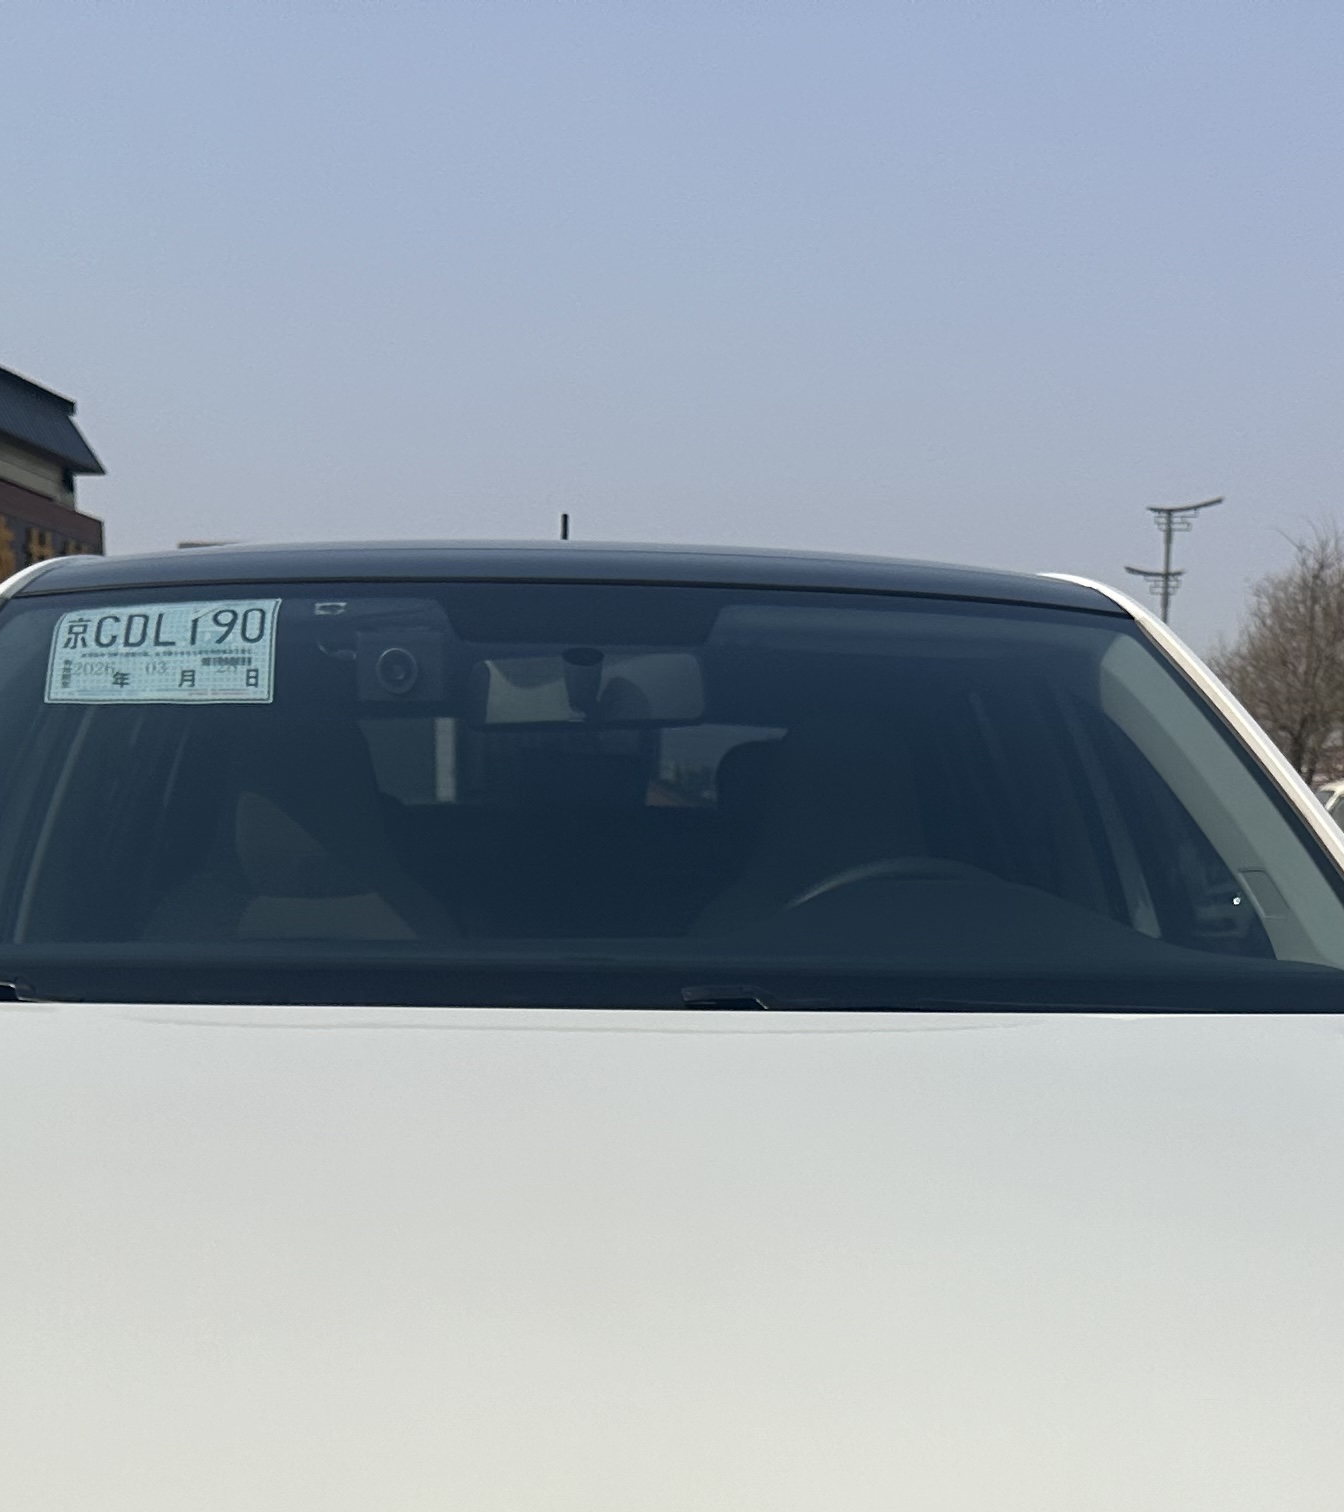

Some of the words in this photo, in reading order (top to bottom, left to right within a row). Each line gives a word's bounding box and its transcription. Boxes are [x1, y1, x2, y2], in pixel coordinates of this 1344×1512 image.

[112, 671, 131, 688] 年
[178, 669, 196, 687] 月
[245, 668, 259, 688] 日
